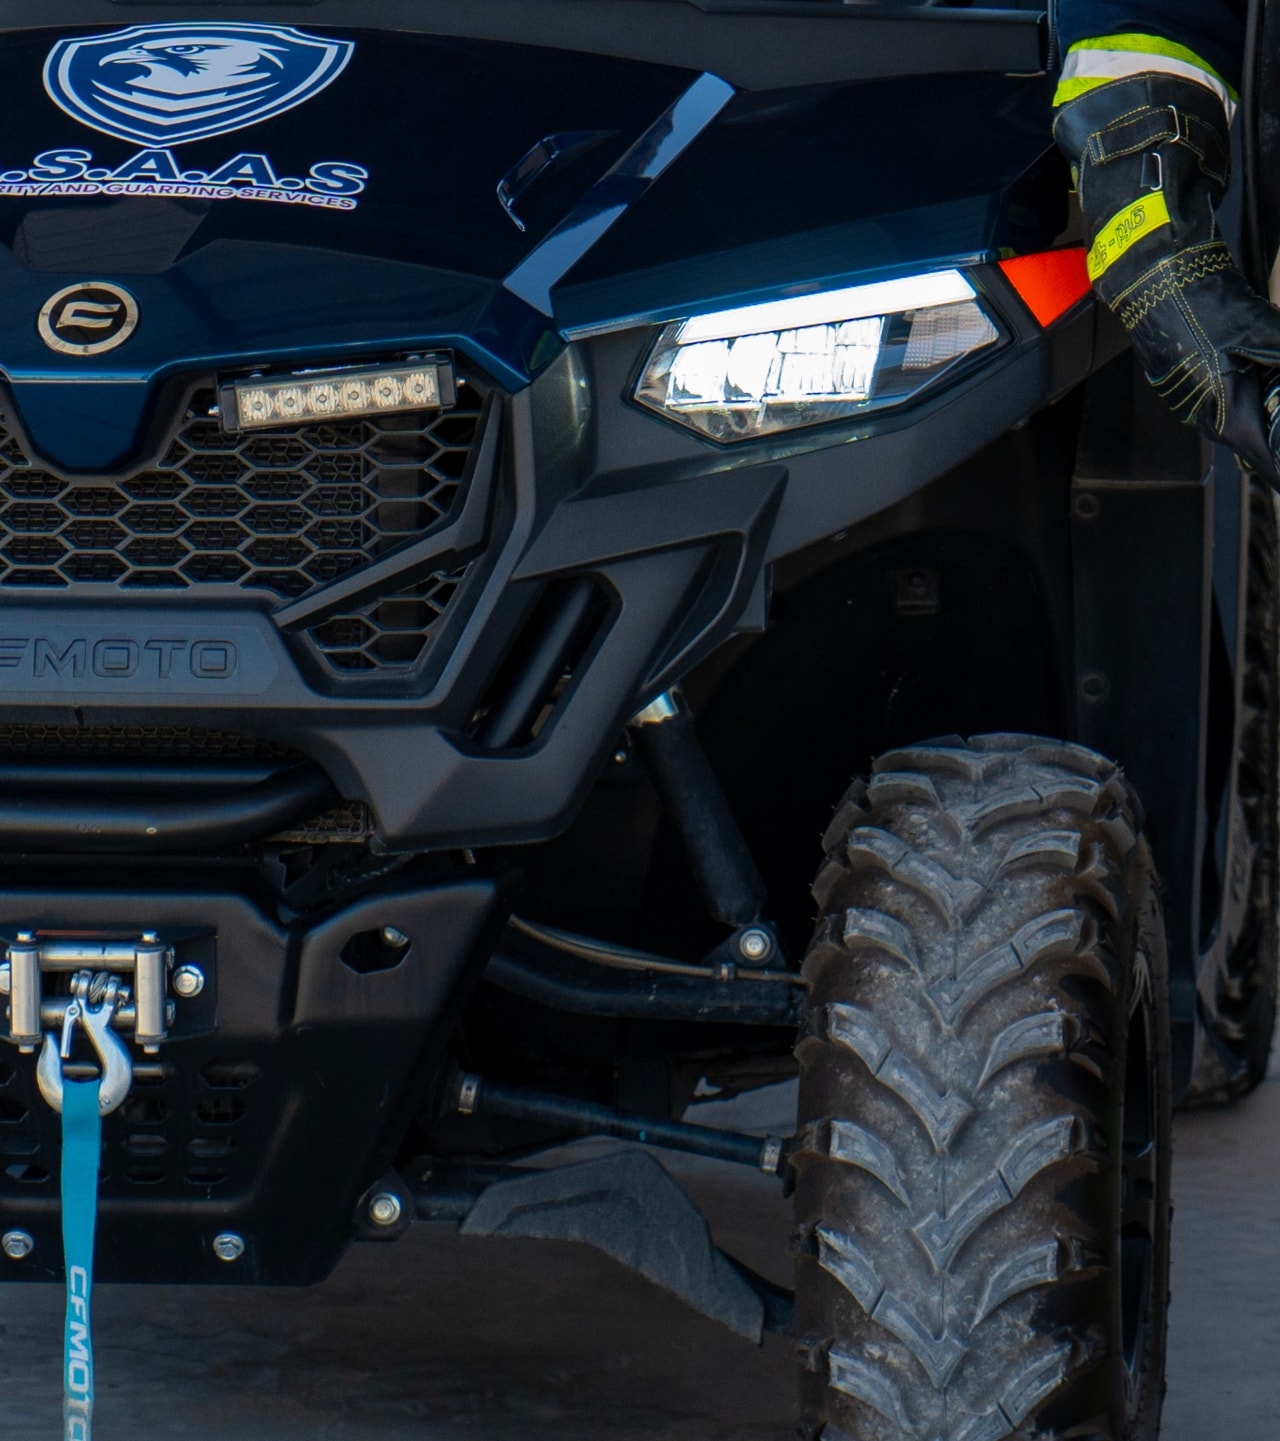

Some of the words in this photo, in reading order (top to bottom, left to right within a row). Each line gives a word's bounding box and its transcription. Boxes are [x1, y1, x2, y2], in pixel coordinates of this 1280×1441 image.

[47, 183, 99, 195] AND
[106, 184, 235, 198] GUARDING
[239, 188, 355, 209] SERVICES
[69, 1265, 90, 1441] CFMOTO
